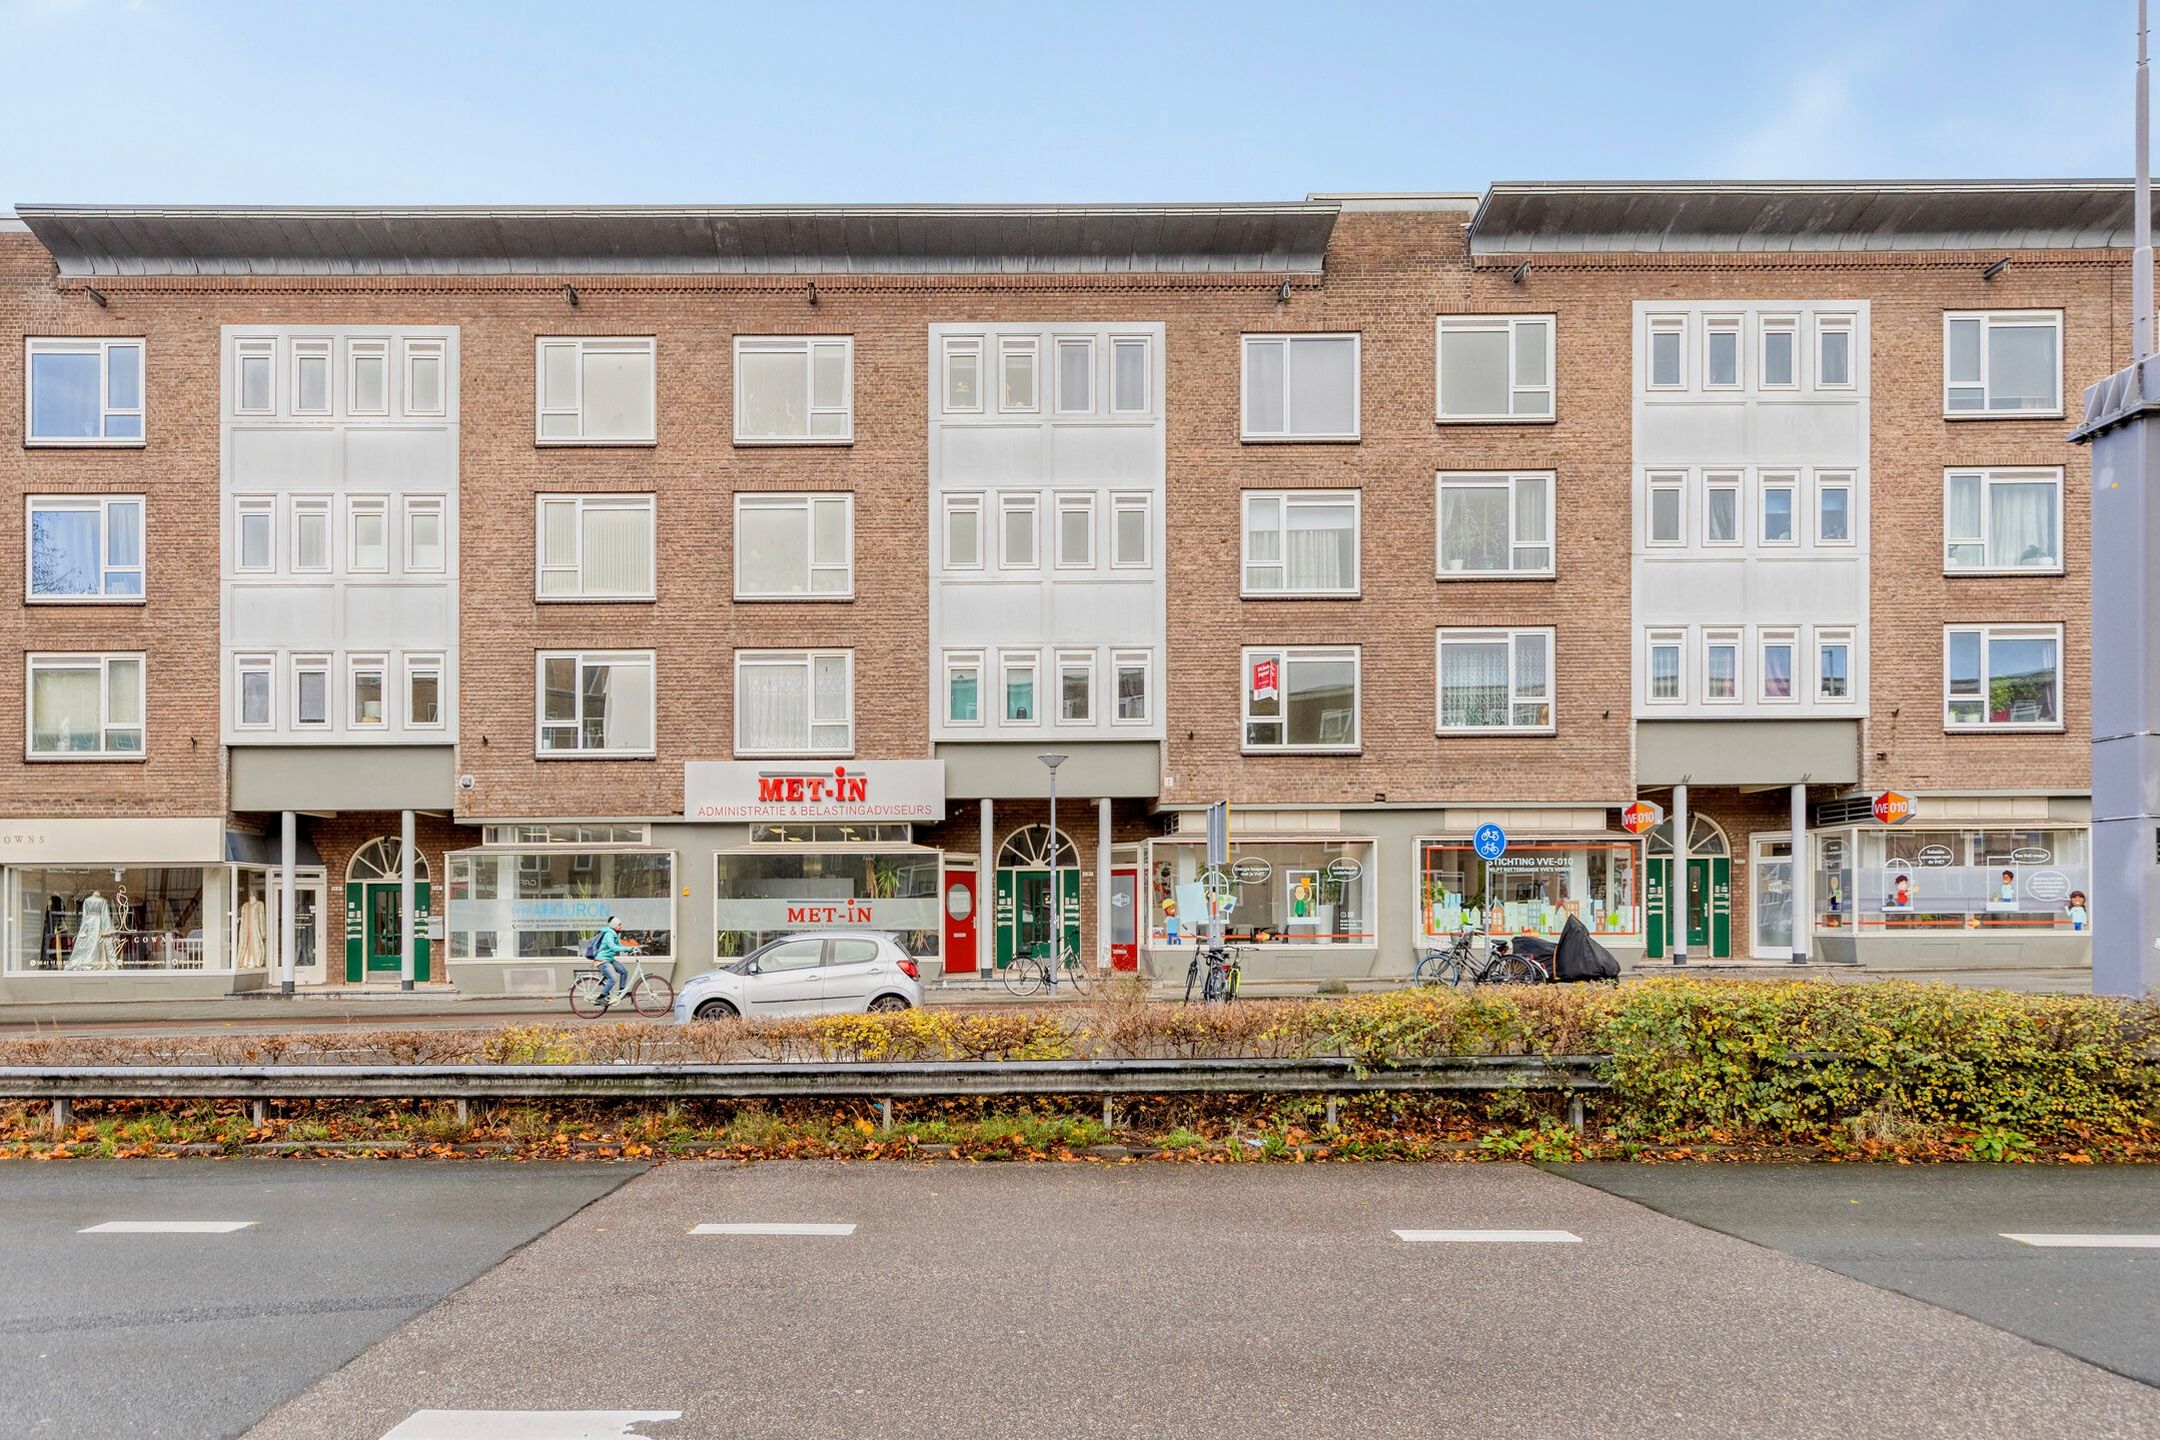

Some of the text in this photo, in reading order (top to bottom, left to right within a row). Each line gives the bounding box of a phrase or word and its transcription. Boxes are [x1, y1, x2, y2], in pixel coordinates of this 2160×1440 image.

[699, 805, 932, 817] ADMINISTRATIE & BELASTINGADVISEURS
[1488, 857, 1574, 866] STICHTING VVE-010
